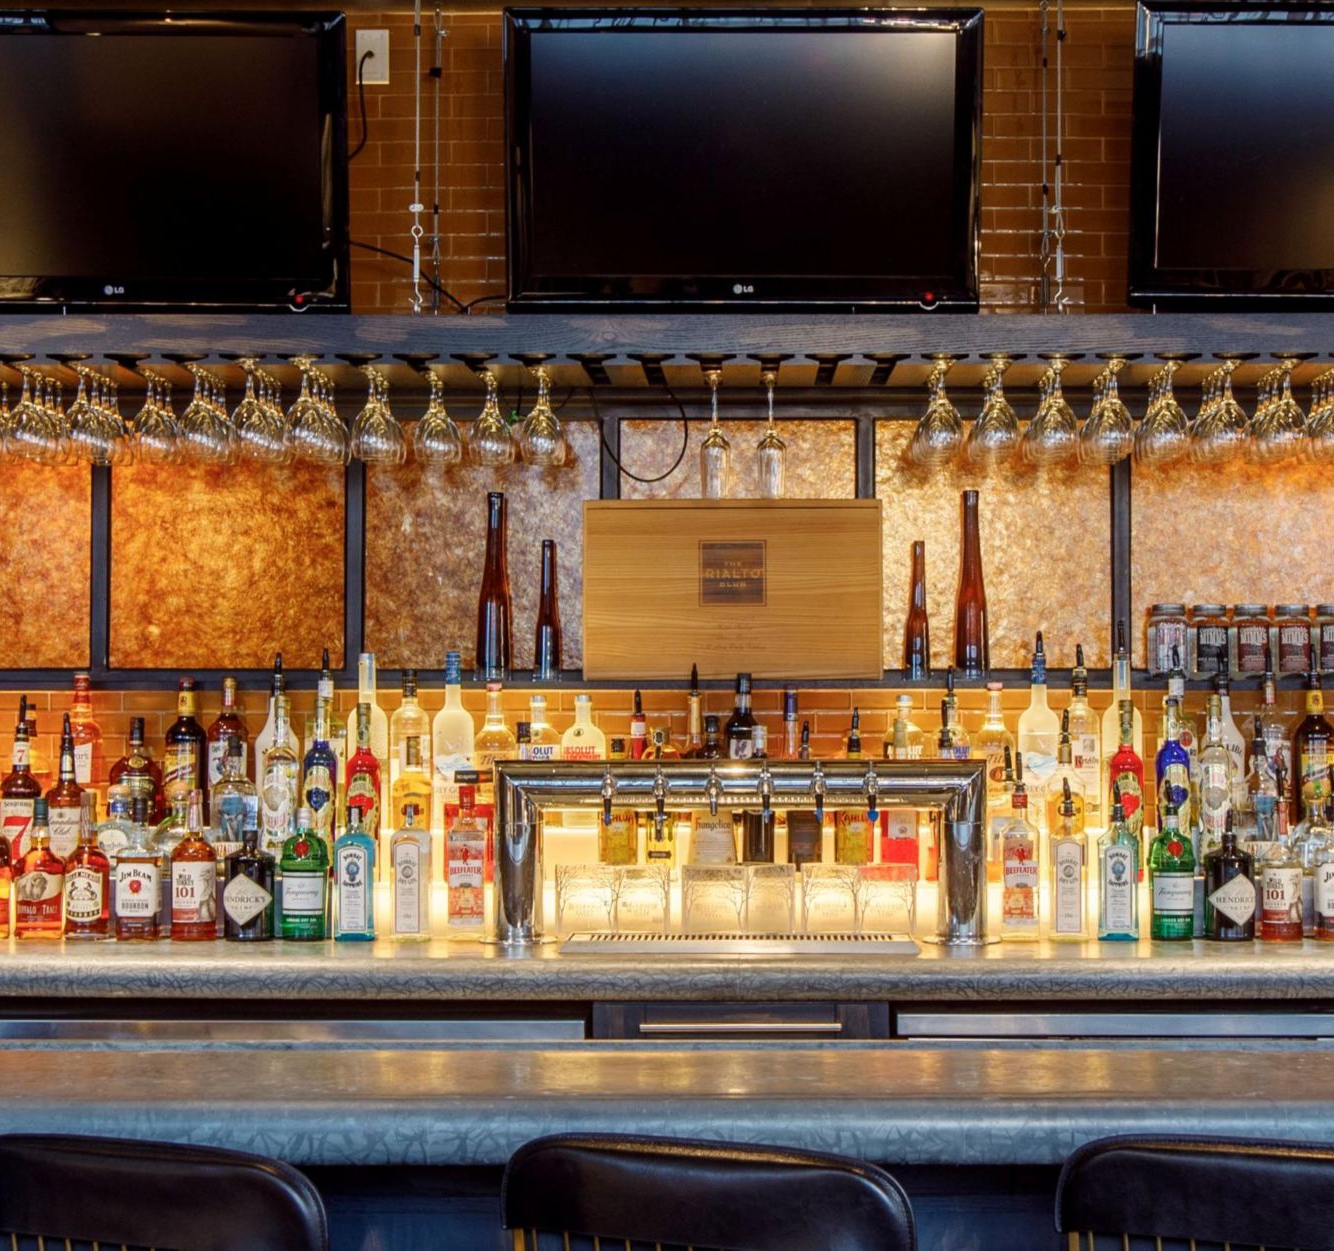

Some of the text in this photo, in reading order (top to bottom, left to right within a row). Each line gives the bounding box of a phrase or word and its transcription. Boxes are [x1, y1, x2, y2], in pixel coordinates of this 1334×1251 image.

[705, 568, 762, 579] RIALTO
[533, 746, 553, 755] OLUT
[17, 750, 25, 762] 7
[3, 816, 33, 860] 7
[342, 852, 362, 861] BOMBAY
[1058, 856, 1079, 866] BOMBAY
[1108, 852, 1128, 861] BOMBAY
[397, 859, 418, 868] BOMBAY
[449, 866, 482, 875] BEEFEATER
[1005, 866, 1038, 875] BEEFEATER
[119, 869, 152, 883] JIM BEAM
[342, 880, 363, 888] SAPPHIRE
[1108, 879, 1129, 888] SAPPHIRE
[175, 886, 195, 898] 101
[1266, 889, 1285, 900] 101
